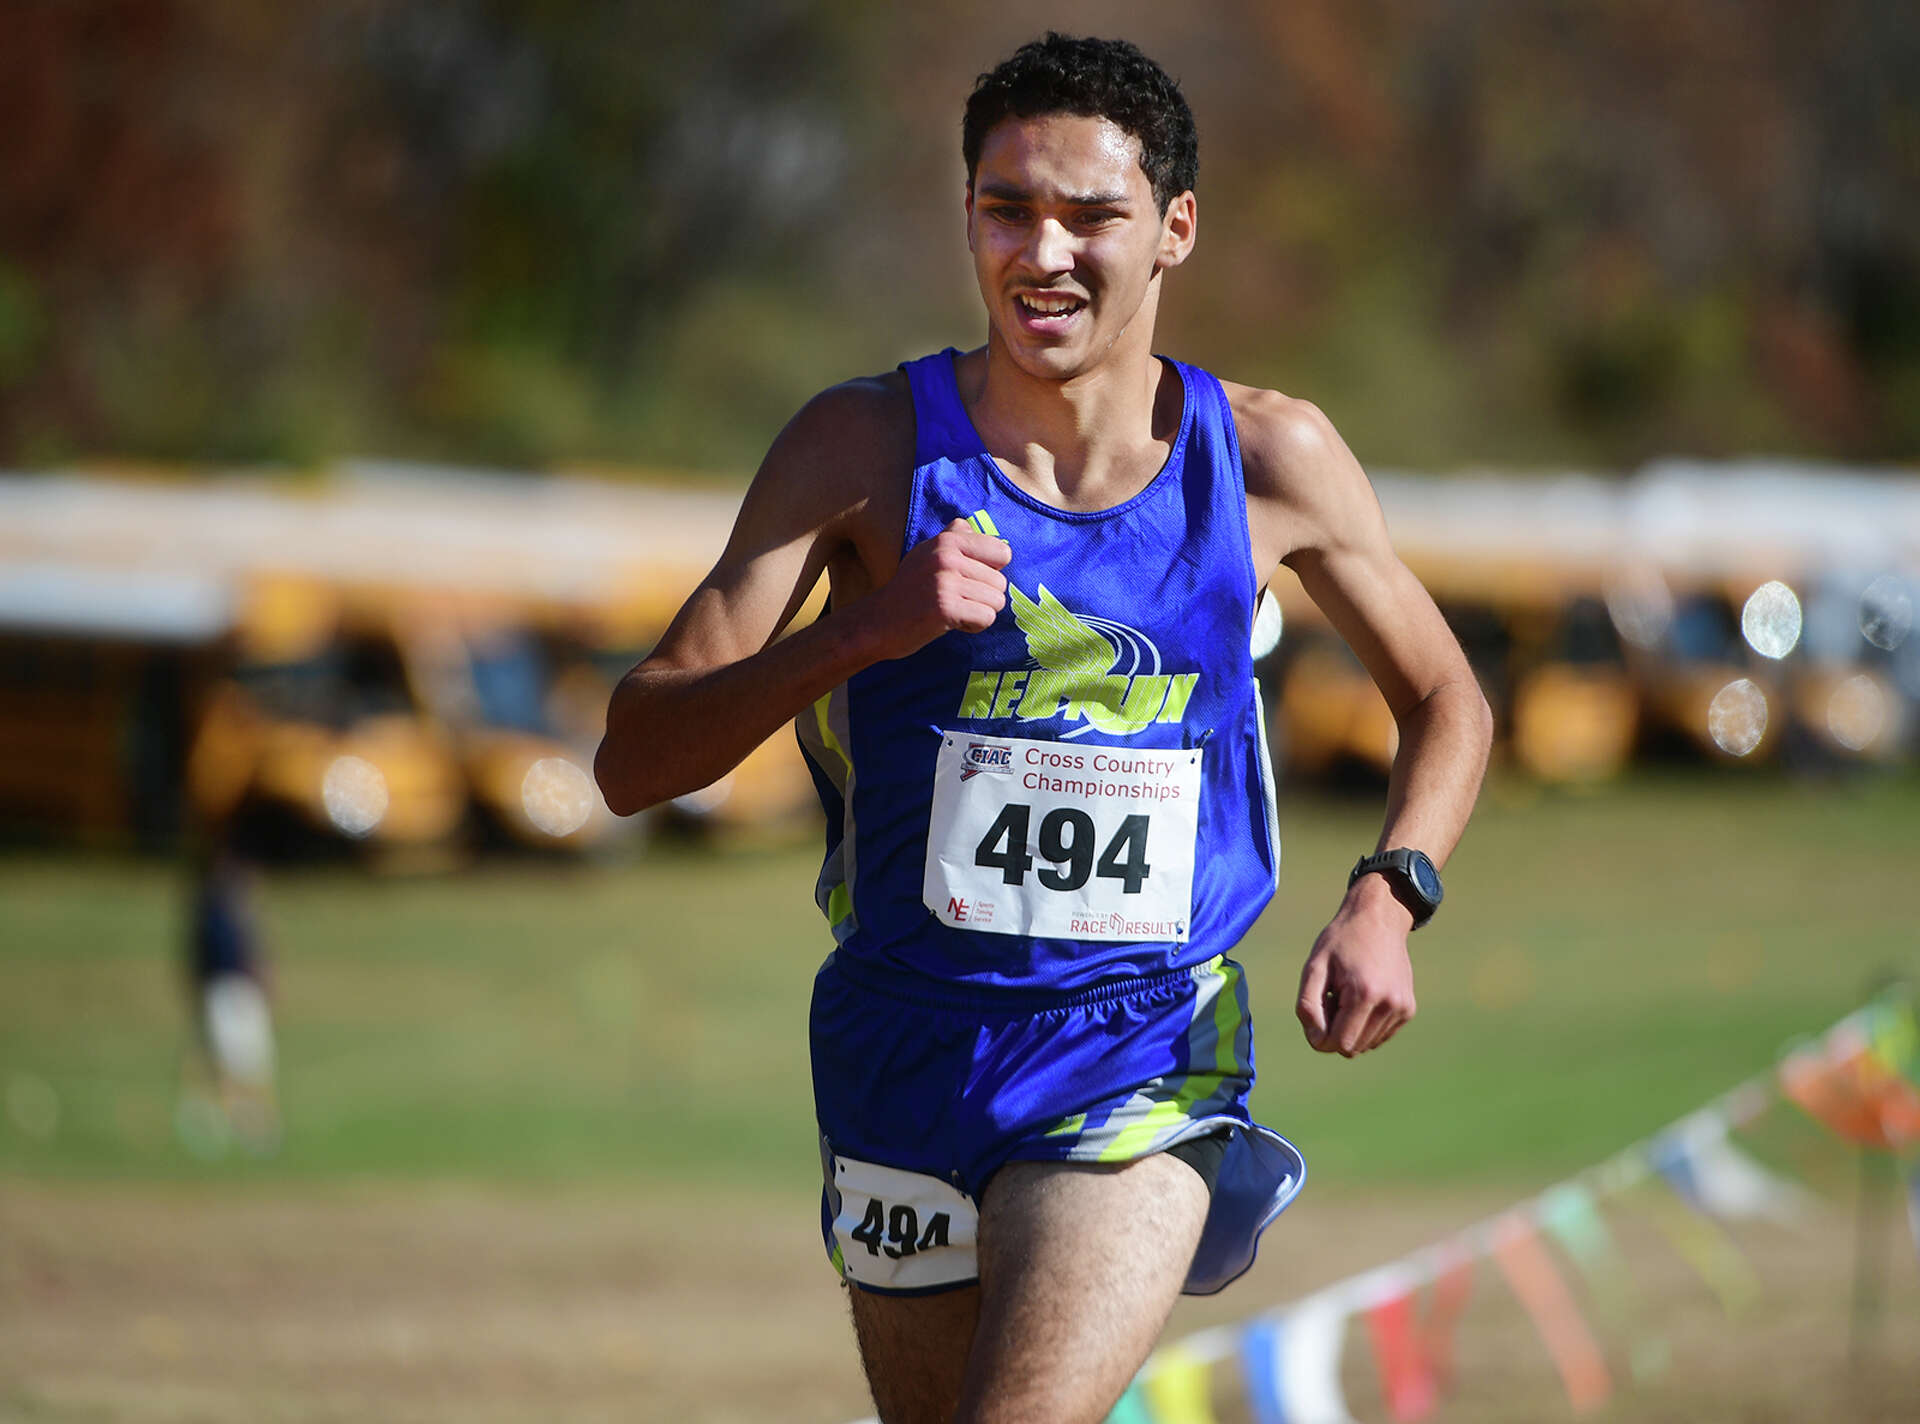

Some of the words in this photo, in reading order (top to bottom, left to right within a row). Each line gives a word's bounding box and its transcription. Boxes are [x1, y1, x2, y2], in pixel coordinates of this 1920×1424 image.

[971, 748, 1012, 765] CIAC
[1025, 747, 1084, 769] Cross
[1093, 755, 1175, 777] Country
[1023, 773, 1180, 801] Championships
[974, 802, 1151, 894] 494
[1070, 919, 1107, 934] RACE
[1125, 922, 1174, 935] RESULT
[851, 1198, 951, 1260] 494
